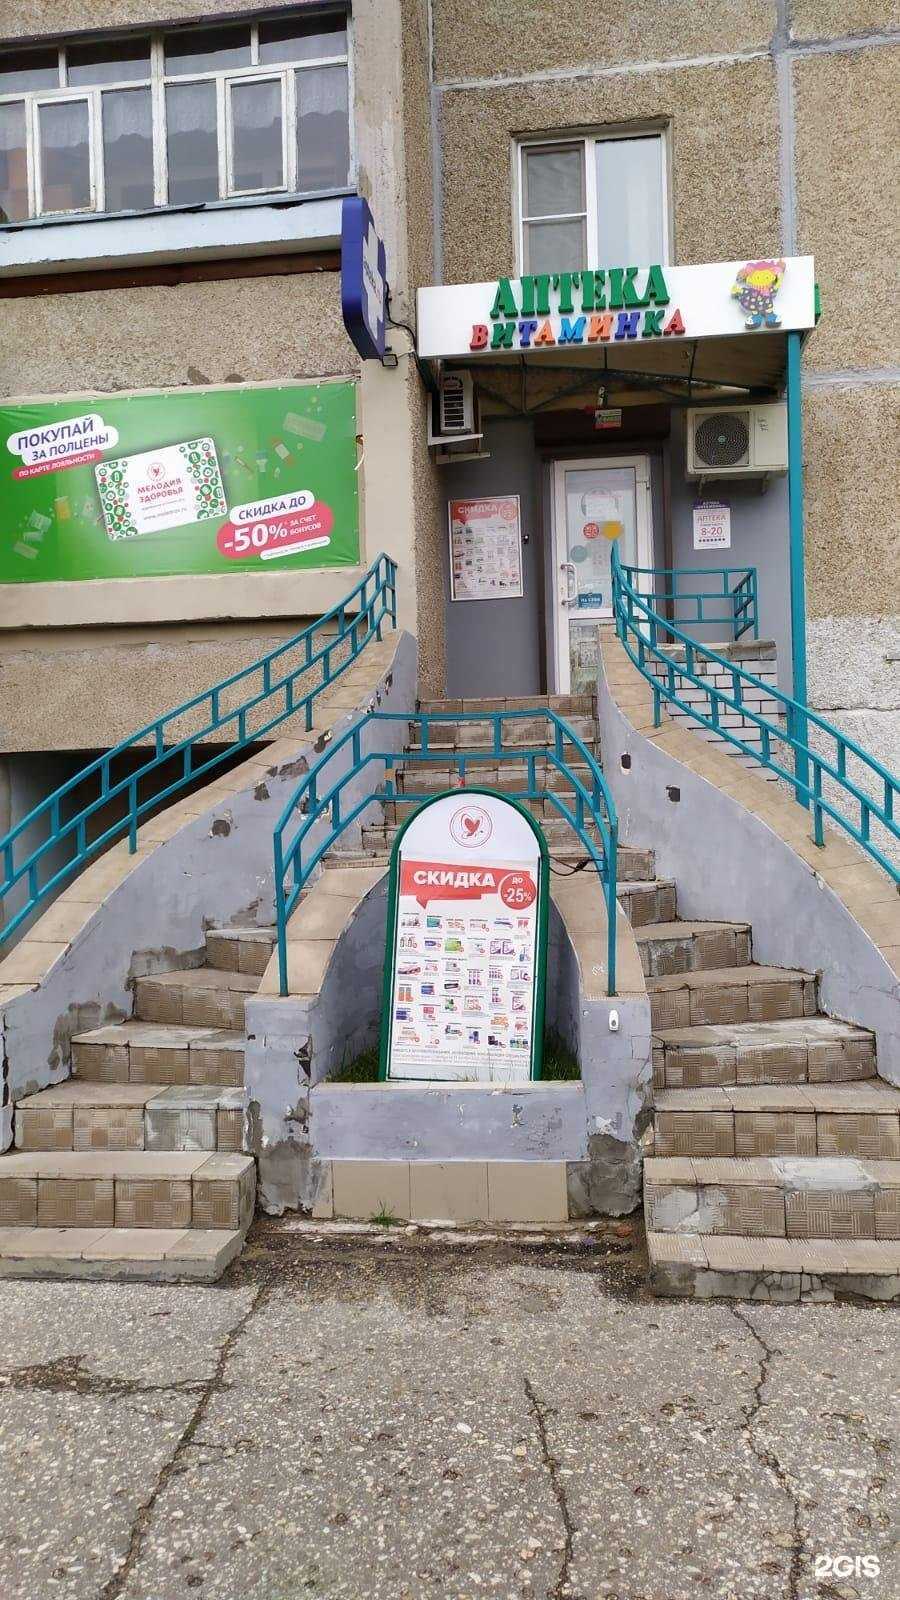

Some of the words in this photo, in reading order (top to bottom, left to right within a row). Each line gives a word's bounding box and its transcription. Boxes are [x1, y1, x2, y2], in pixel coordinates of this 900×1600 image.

[490, 265, 670, 318] АПТЕКА
[469, 308, 686, 351] ВИТАМИНКА
[17, 417, 94, 450] ПОКУПАЙ
[32, 449, 47, 461] ЗА
[49, 433, 109, 457] ПОЛЦЕНЫ
[18, 469, 29, 478] ПО
[30, 465, 51, 475] КАРТЕ
[137, 477, 181, 495] МЕЛОДИЯ
[139, 487, 183, 503] ЗДОРОВЬЯ
[238, 501, 287, 520] СКИДКА
[288, 495, 306, 509] ДО
[289, 519, 299, 527] ЗА
[289, 523, 322, 535] БОНУСОВ
[413, 870, 496, 889] СКИДКА
[504, 888, 532, 903] -25%
